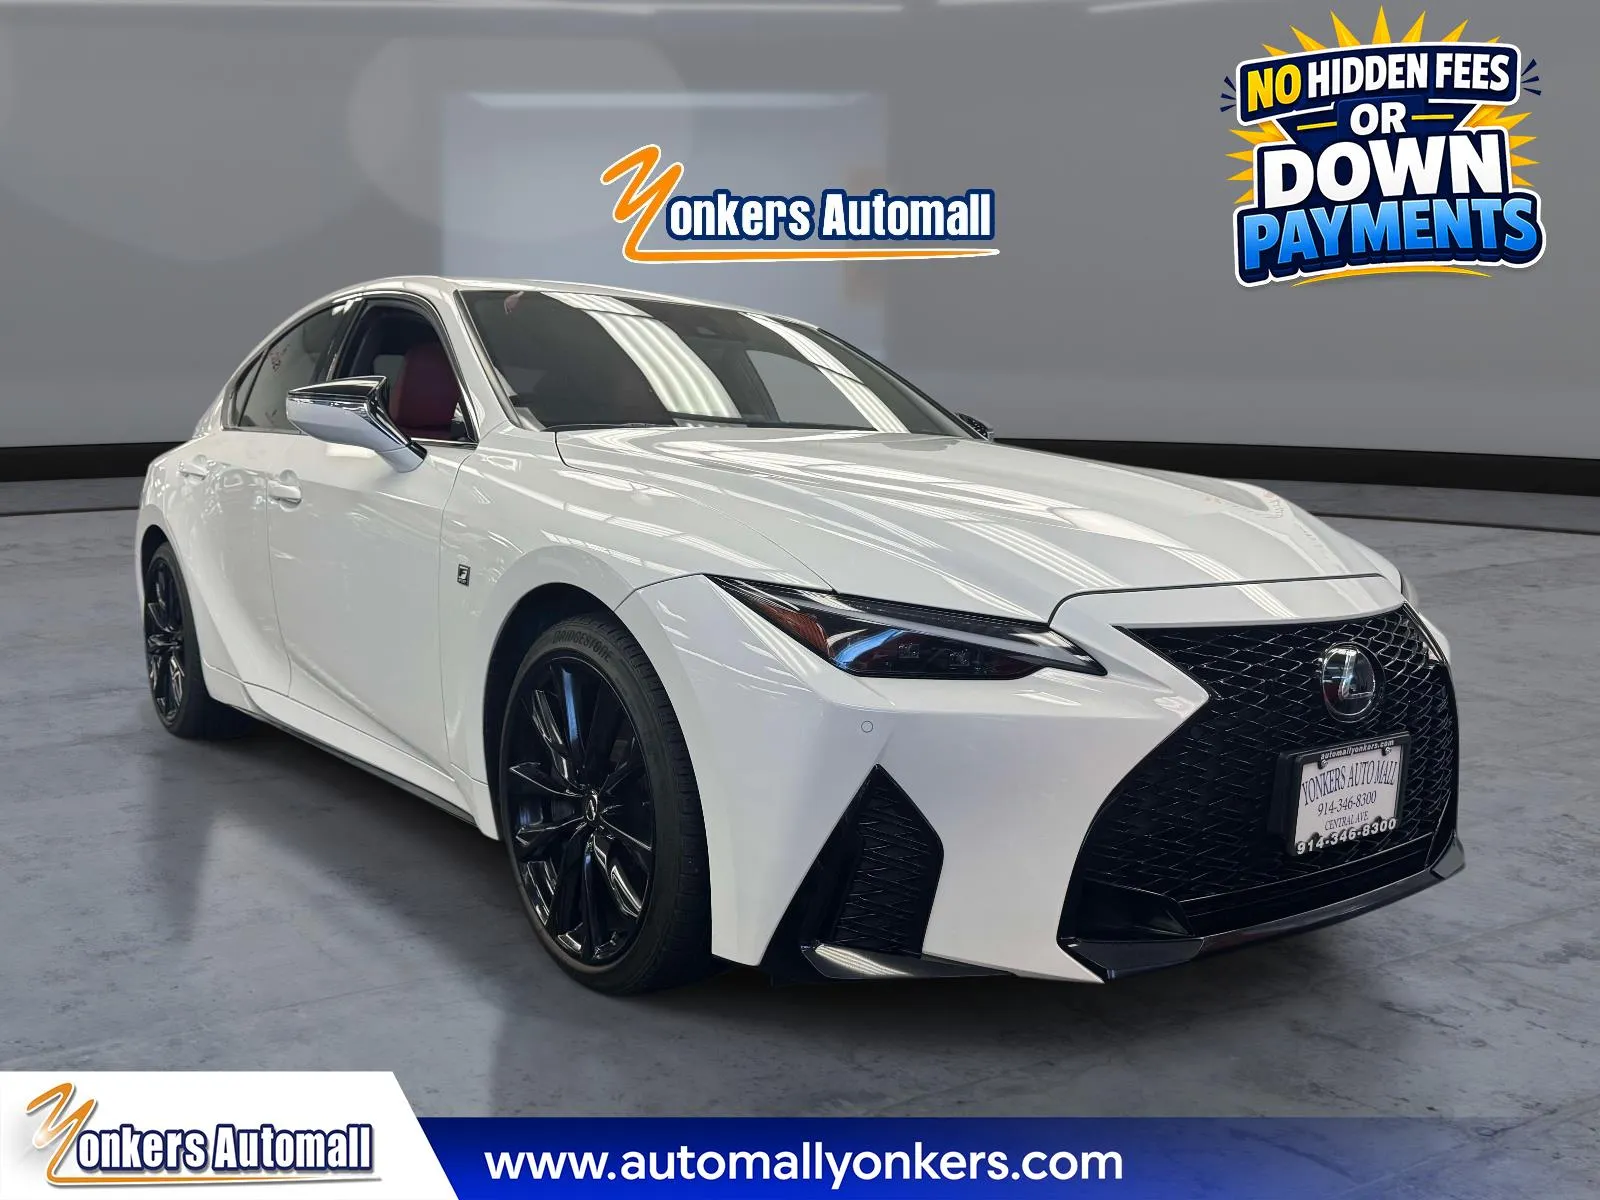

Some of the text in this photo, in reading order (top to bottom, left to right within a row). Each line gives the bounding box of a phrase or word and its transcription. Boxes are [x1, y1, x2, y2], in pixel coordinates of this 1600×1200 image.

[552, 629, 614, 663] BRIDGESTONE
[1320, 739, 1395, 761] automallyonkers.com
[1301, 765, 1346, 806] YONKERS
[1317, 790, 1377, 817] 914-346-8300
[1324, 810, 1369, 831] CENTRAL AVE
[1296, 817, 1397, 855] 914-346-8300
